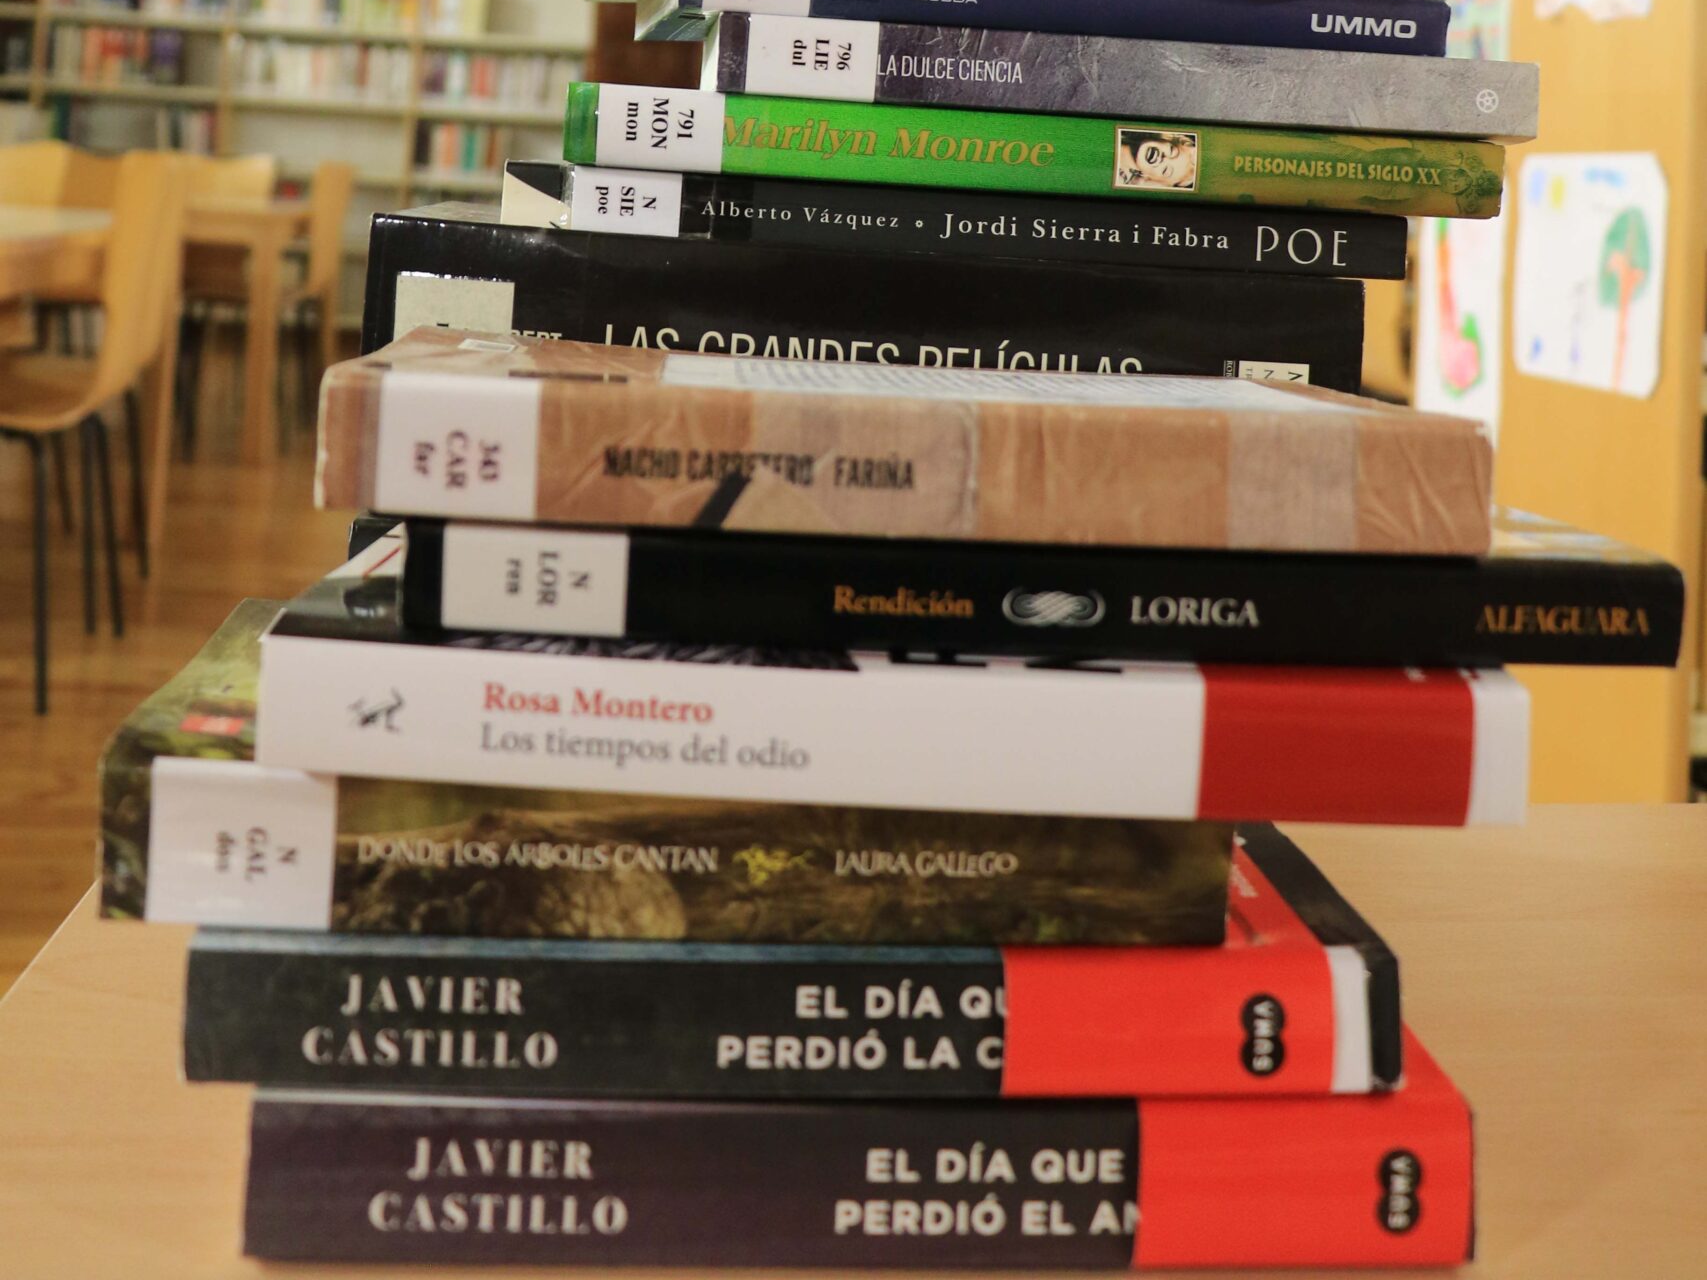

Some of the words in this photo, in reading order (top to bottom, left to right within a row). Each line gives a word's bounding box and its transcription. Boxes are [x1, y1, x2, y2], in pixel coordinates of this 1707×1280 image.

[1310, 13, 1418, 40] UMMO
[792, 39, 808, 67] dul
[814, 38, 831, 71] LIE
[837, 42, 852, 71] 796
[877, 54, 898, 77] LA
[901, 55, 955, 81] DULCE
[958, 58, 1023, 85] CIENCIA
[625, 101, 640, 142] mon
[651, 97, 670, 150] MON
[678, 109, 694, 140] 791
[723, 116, 878, 160] Marilyn
[888, 128, 1055, 167] Monroe
[1234, 156, 1333, 178] PERSONAJES
[1335, 162, 1365, 180] DEL
[1367, 164, 1414, 182] SIGLO
[1416, 167, 1441, 185] XX
[595, 185, 609, 215] poe
[619, 185, 636, 217] SIE
[642, 196, 657, 210] N
[702, 201, 792, 221] Alberto
[804, 207, 899, 230] Vázquez
[940, 213, 1018, 240] Jordi
[1032, 218, 1121, 244] Sierra
[1131, 224, 1140, 244] i
[1151, 226, 1230, 250] Fabra
[1256, 225, 1348, 267] POE
[444, 429, 468, 491] CAR
[603, 447, 678, 480] NACHO
[833, 453, 914, 489] FARIÑA
[536, 550, 560, 606] LOR
[571, 570, 590, 591] N
[833, 585, 974, 617] Rendición
[1130, 596, 1259, 627] LORIGA
[1476, 604, 1650, 636] ALFAGUARA
[484, 682, 560, 714] Rosa
[571, 688, 714, 723] Montero
[480, 723, 535, 753] Los
[545, 728, 671, 768] tiempos
[680, 733, 729, 765] del
[736, 737, 810, 770] odio
[245, 826, 269, 882] GAL
[276, 846, 297, 865] N
[454, 841, 500, 867] LOS
[613, 844, 719, 873] CANTAN
[834, 850, 914, 876] LAURA
[915, 851, 1019, 877] GALLEGO
[341, 974, 524, 1015] JAVIER
[795, 986, 848, 1018] EL
[865, 979, 943, 1018] DÍA
[302, 1026, 558, 1068] CASTILLO
[717, 1029, 886, 1069] PERDIÓ
[903, 1036, 961, 1069] LA
[1252, 1000, 1275, 1071] SUMA
[407, 1137, 593, 1180] JAVIER
[866, 1149, 920, 1183] EL
[936, 1142, 1016, 1183] DÍA
[1031, 1150, 1125, 1183] QUE
[1388, 1156, 1411, 1229] SUMA
[368, 1191, 629, 1234] CASTILLO
[834, 1193, 1006, 1235] PERDIÓ
[1021, 1201, 1074, 1235] EL
